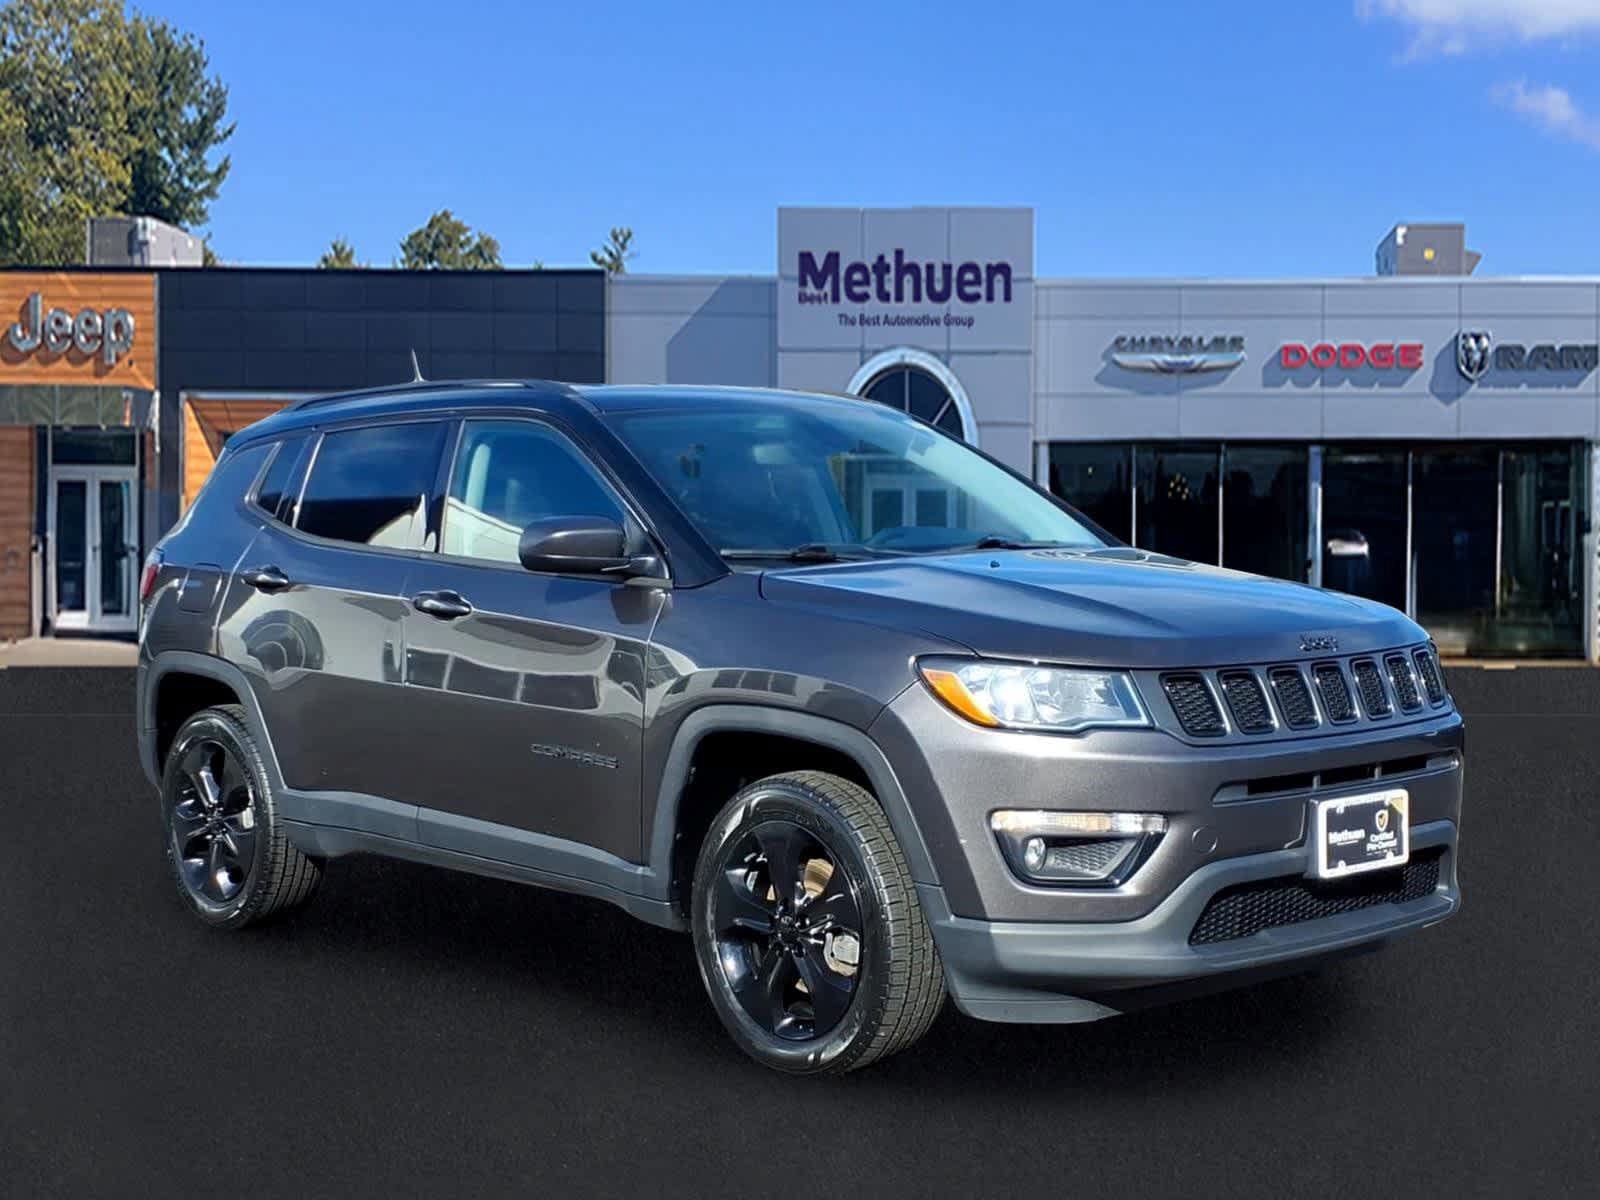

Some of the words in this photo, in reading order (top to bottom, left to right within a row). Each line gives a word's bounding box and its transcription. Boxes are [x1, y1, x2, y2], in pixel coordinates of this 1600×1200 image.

[798, 249, 1012, 304] Methuen
[9, 292, 135, 365] Jeep
[838, 314, 857, 327] The
[859, 314, 880, 327] Best
[883, 314, 941, 327] Automotive
[943, 314, 974, 328] Group
[1114, 336, 1245, 350] CHRYSLER
[1281, 344, 1423, 368] DODGE
[1496, 344, 1599, 369] RAM
